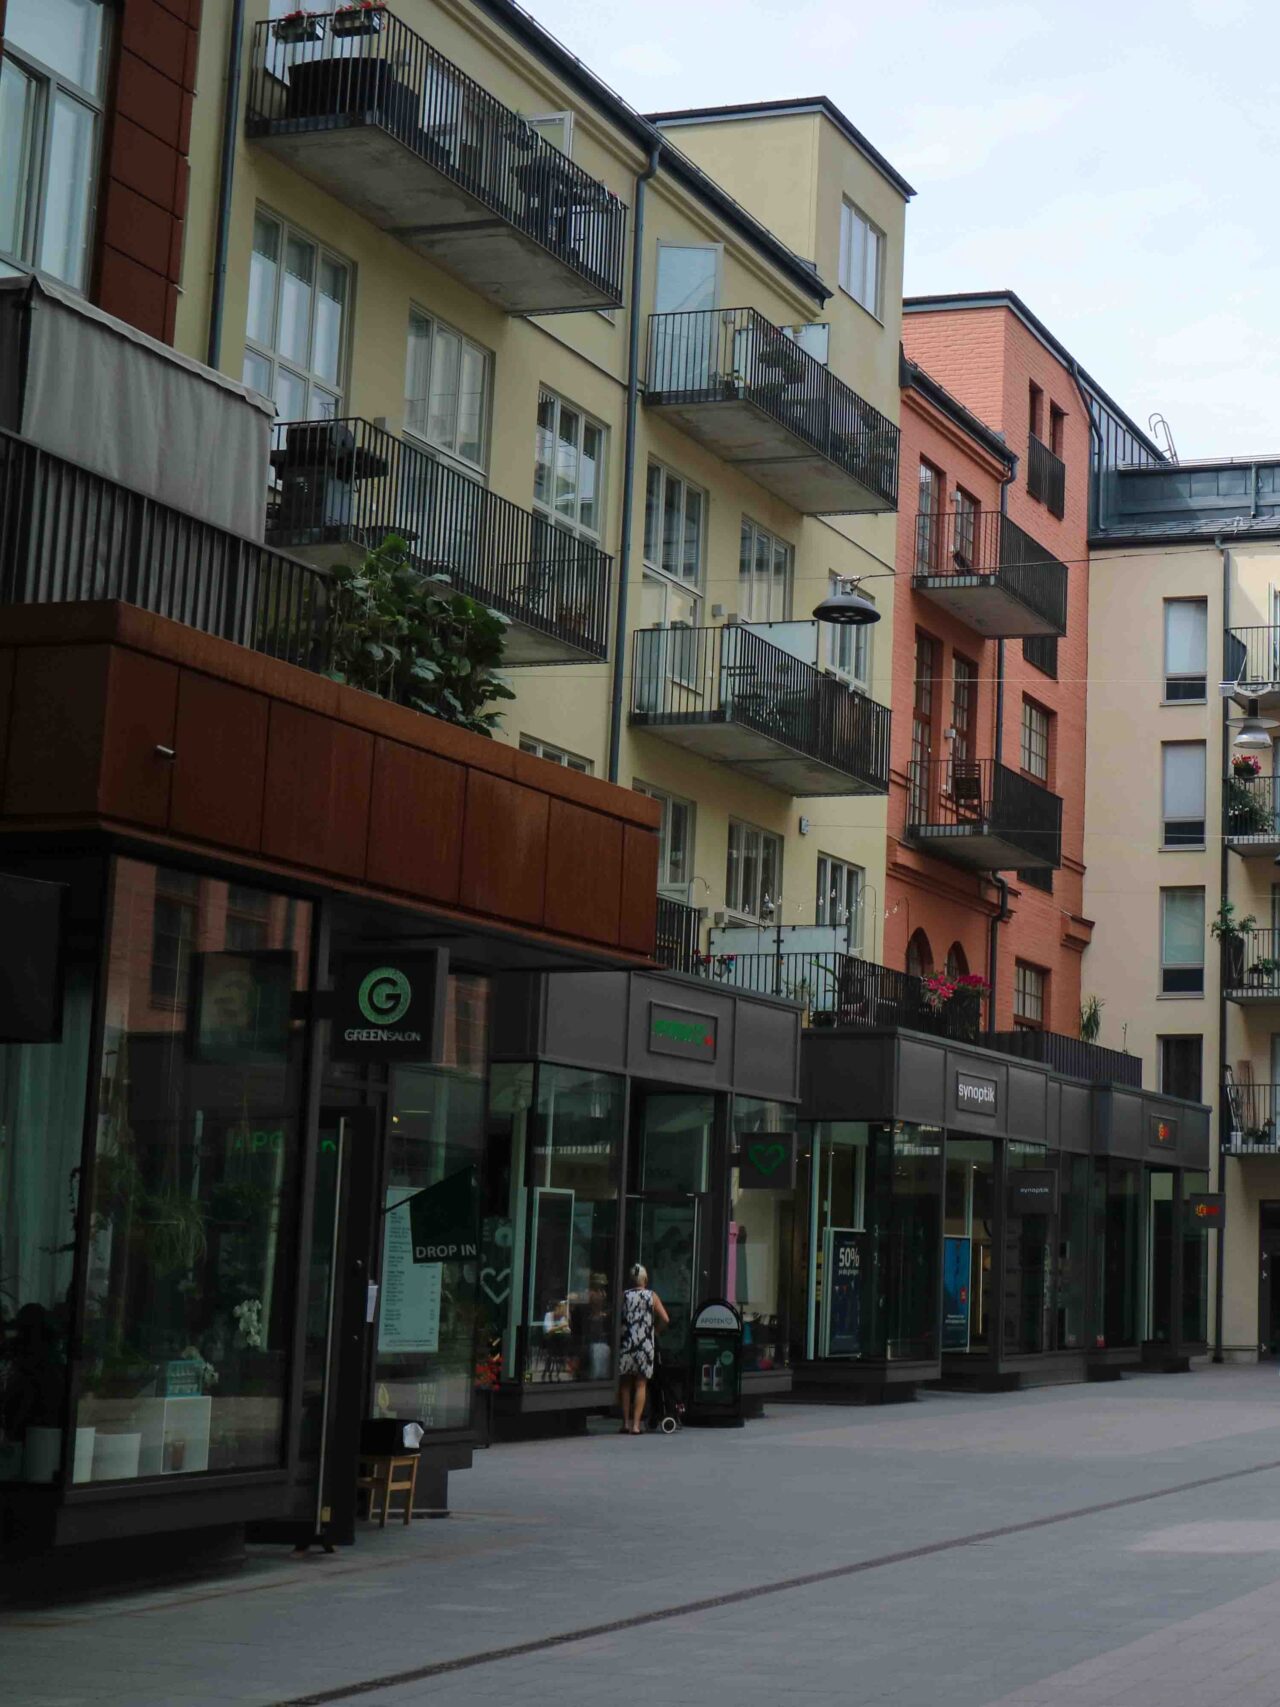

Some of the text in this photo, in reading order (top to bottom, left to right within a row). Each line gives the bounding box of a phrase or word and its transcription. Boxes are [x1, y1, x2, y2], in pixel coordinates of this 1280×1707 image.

[958, 1083, 995, 1103] synoptik
[415, 1243, 478, 1259] DROP IN
[838, 1247, 860, 1267] 50%
